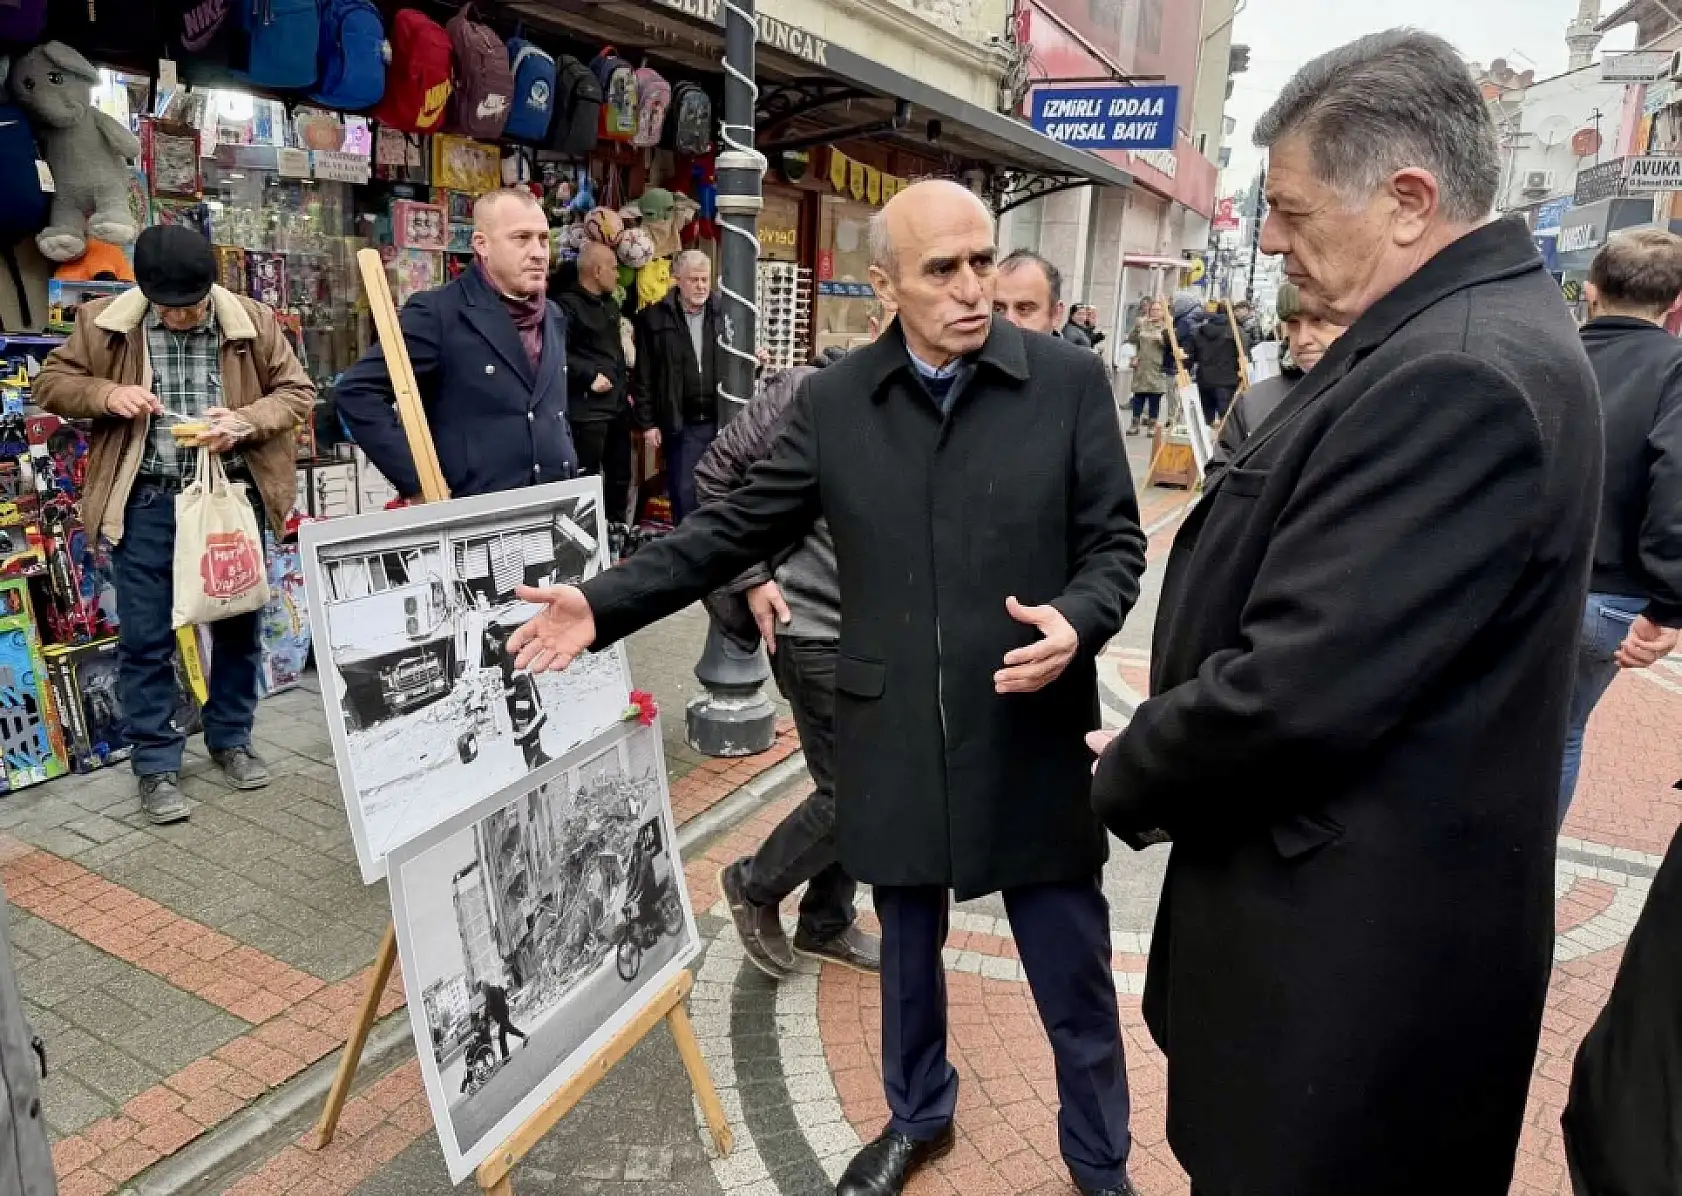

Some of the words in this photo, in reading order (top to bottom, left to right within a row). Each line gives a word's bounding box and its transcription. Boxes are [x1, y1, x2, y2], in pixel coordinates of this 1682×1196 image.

[1042, 99, 1103, 117] İZMİRLİ
[1108, 98, 1164, 117] İDDAA
[1045, 121, 1106, 141] SAYISAL
[1111, 121, 1159, 141] BAYİİ
